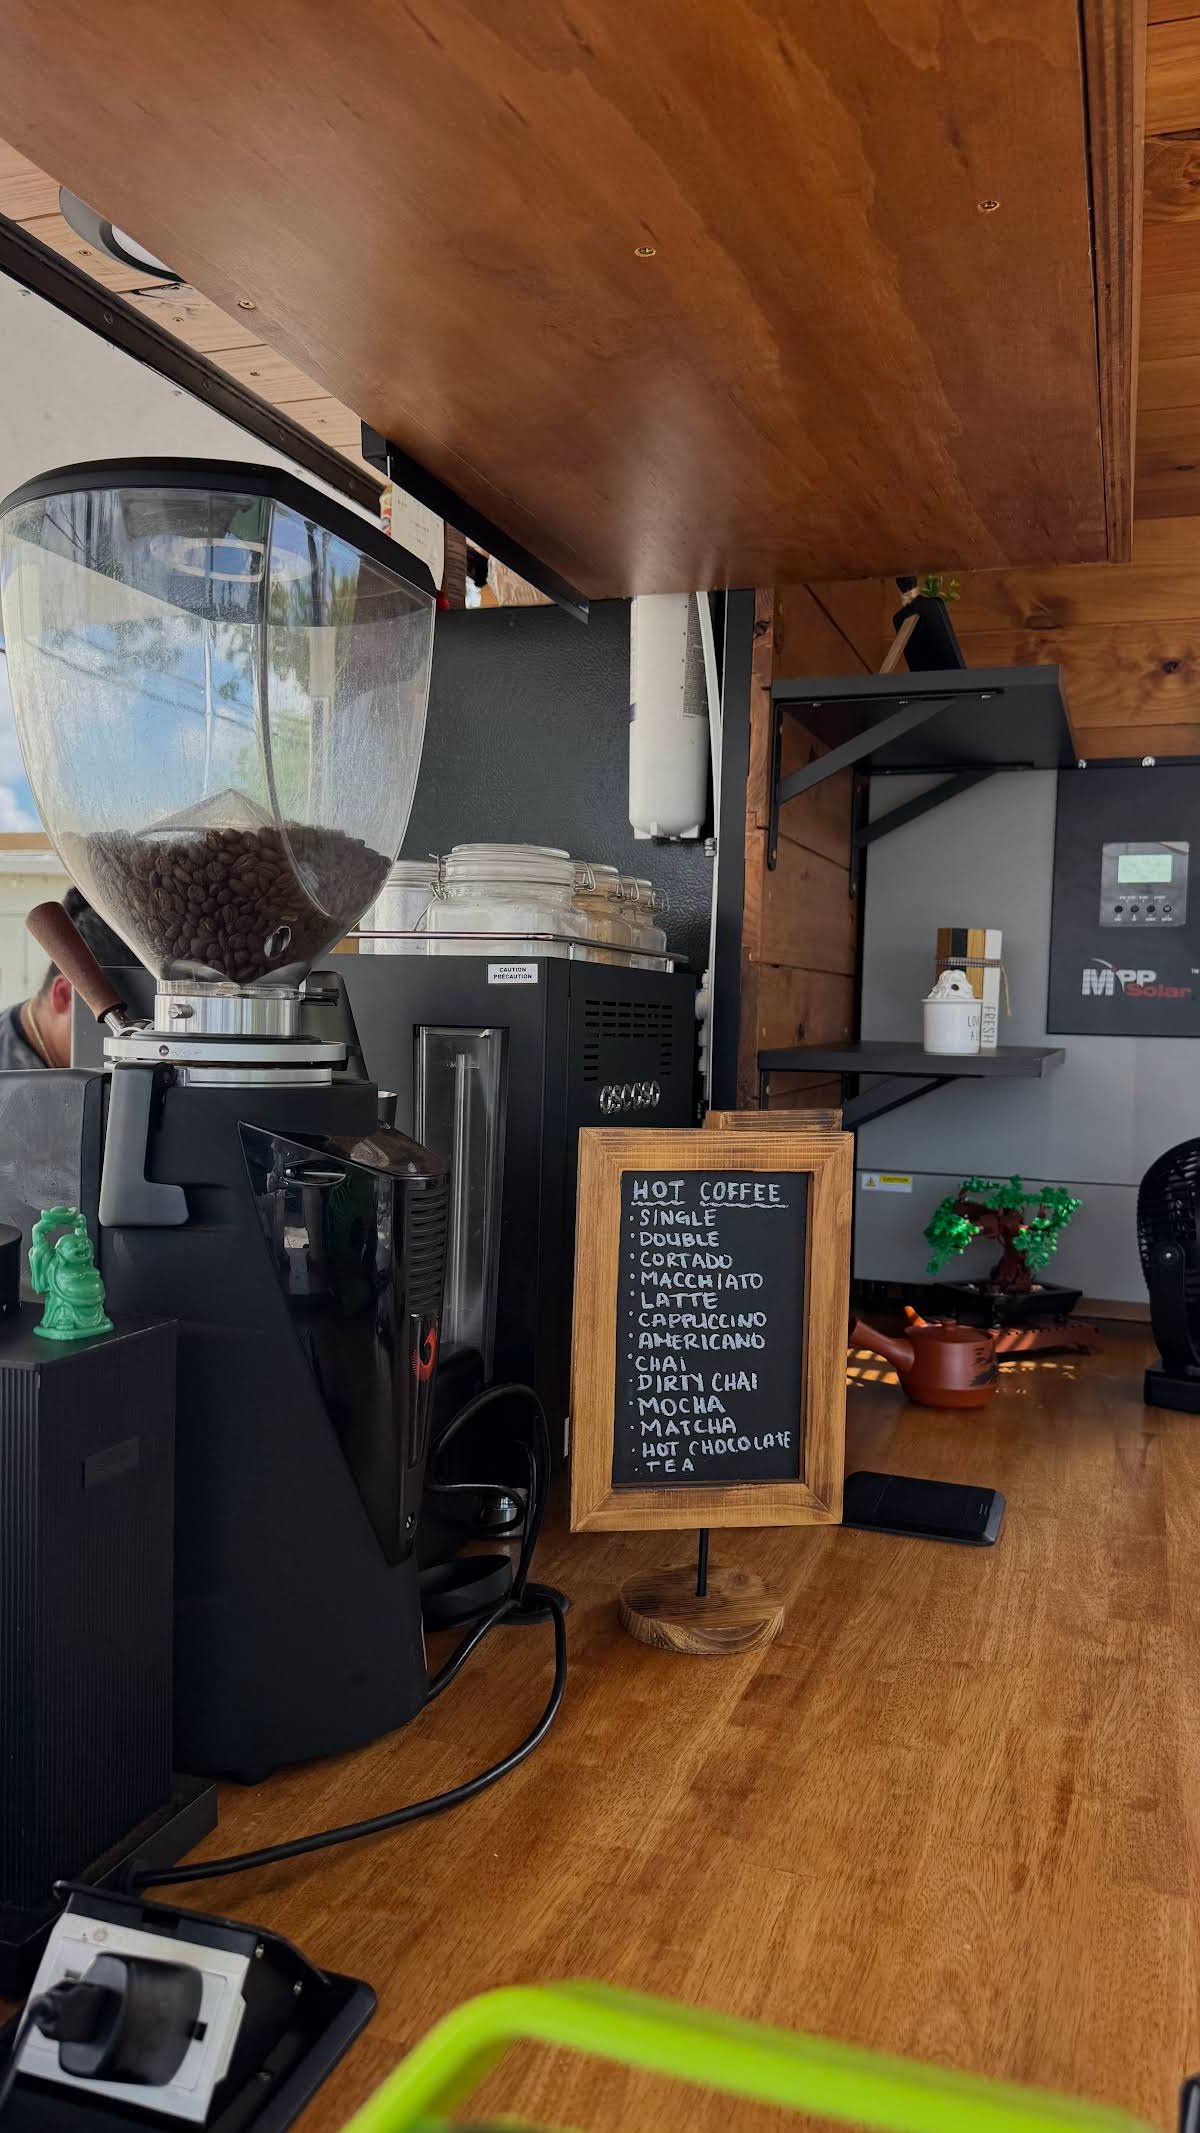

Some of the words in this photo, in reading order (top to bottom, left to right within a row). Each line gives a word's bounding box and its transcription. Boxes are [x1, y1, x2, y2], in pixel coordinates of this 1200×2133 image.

[1081, 968, 1157, 996] MPP
[1125, 983, 1192, 998] Solar
[982, 1005, 997, 1044] FRESH
[632, 1180, 685, 1201] HOT
[700, 1181, 781, 1203] COFFEE
[639, 1208, 717, 1227] SINGLE
[639, 1230, 720, 1248] DOUBLE
[639, 1250, 733, 1270] CORTADO
[640, 1271, 764, 1291] MACCHIATO
[641, 1291, 719, 1310] LATTE
[638, 1311, 768, 1331] CAPPUCCINO
[637, 1331, 766, 1351] AMERICANO
[636, 1373, 705, 1394] DIRTY
[711, 1370, 759, 1393] CHAI
[636, 1394, 727, 1417] MOCHA
[640, 1416, 737, 1438] MATCHA
[642, 1441, 680, 1459] HOT
[688, 1430, 792, 1457] CHOCOLATE
[646, 1457, 695, 1473] TEA
